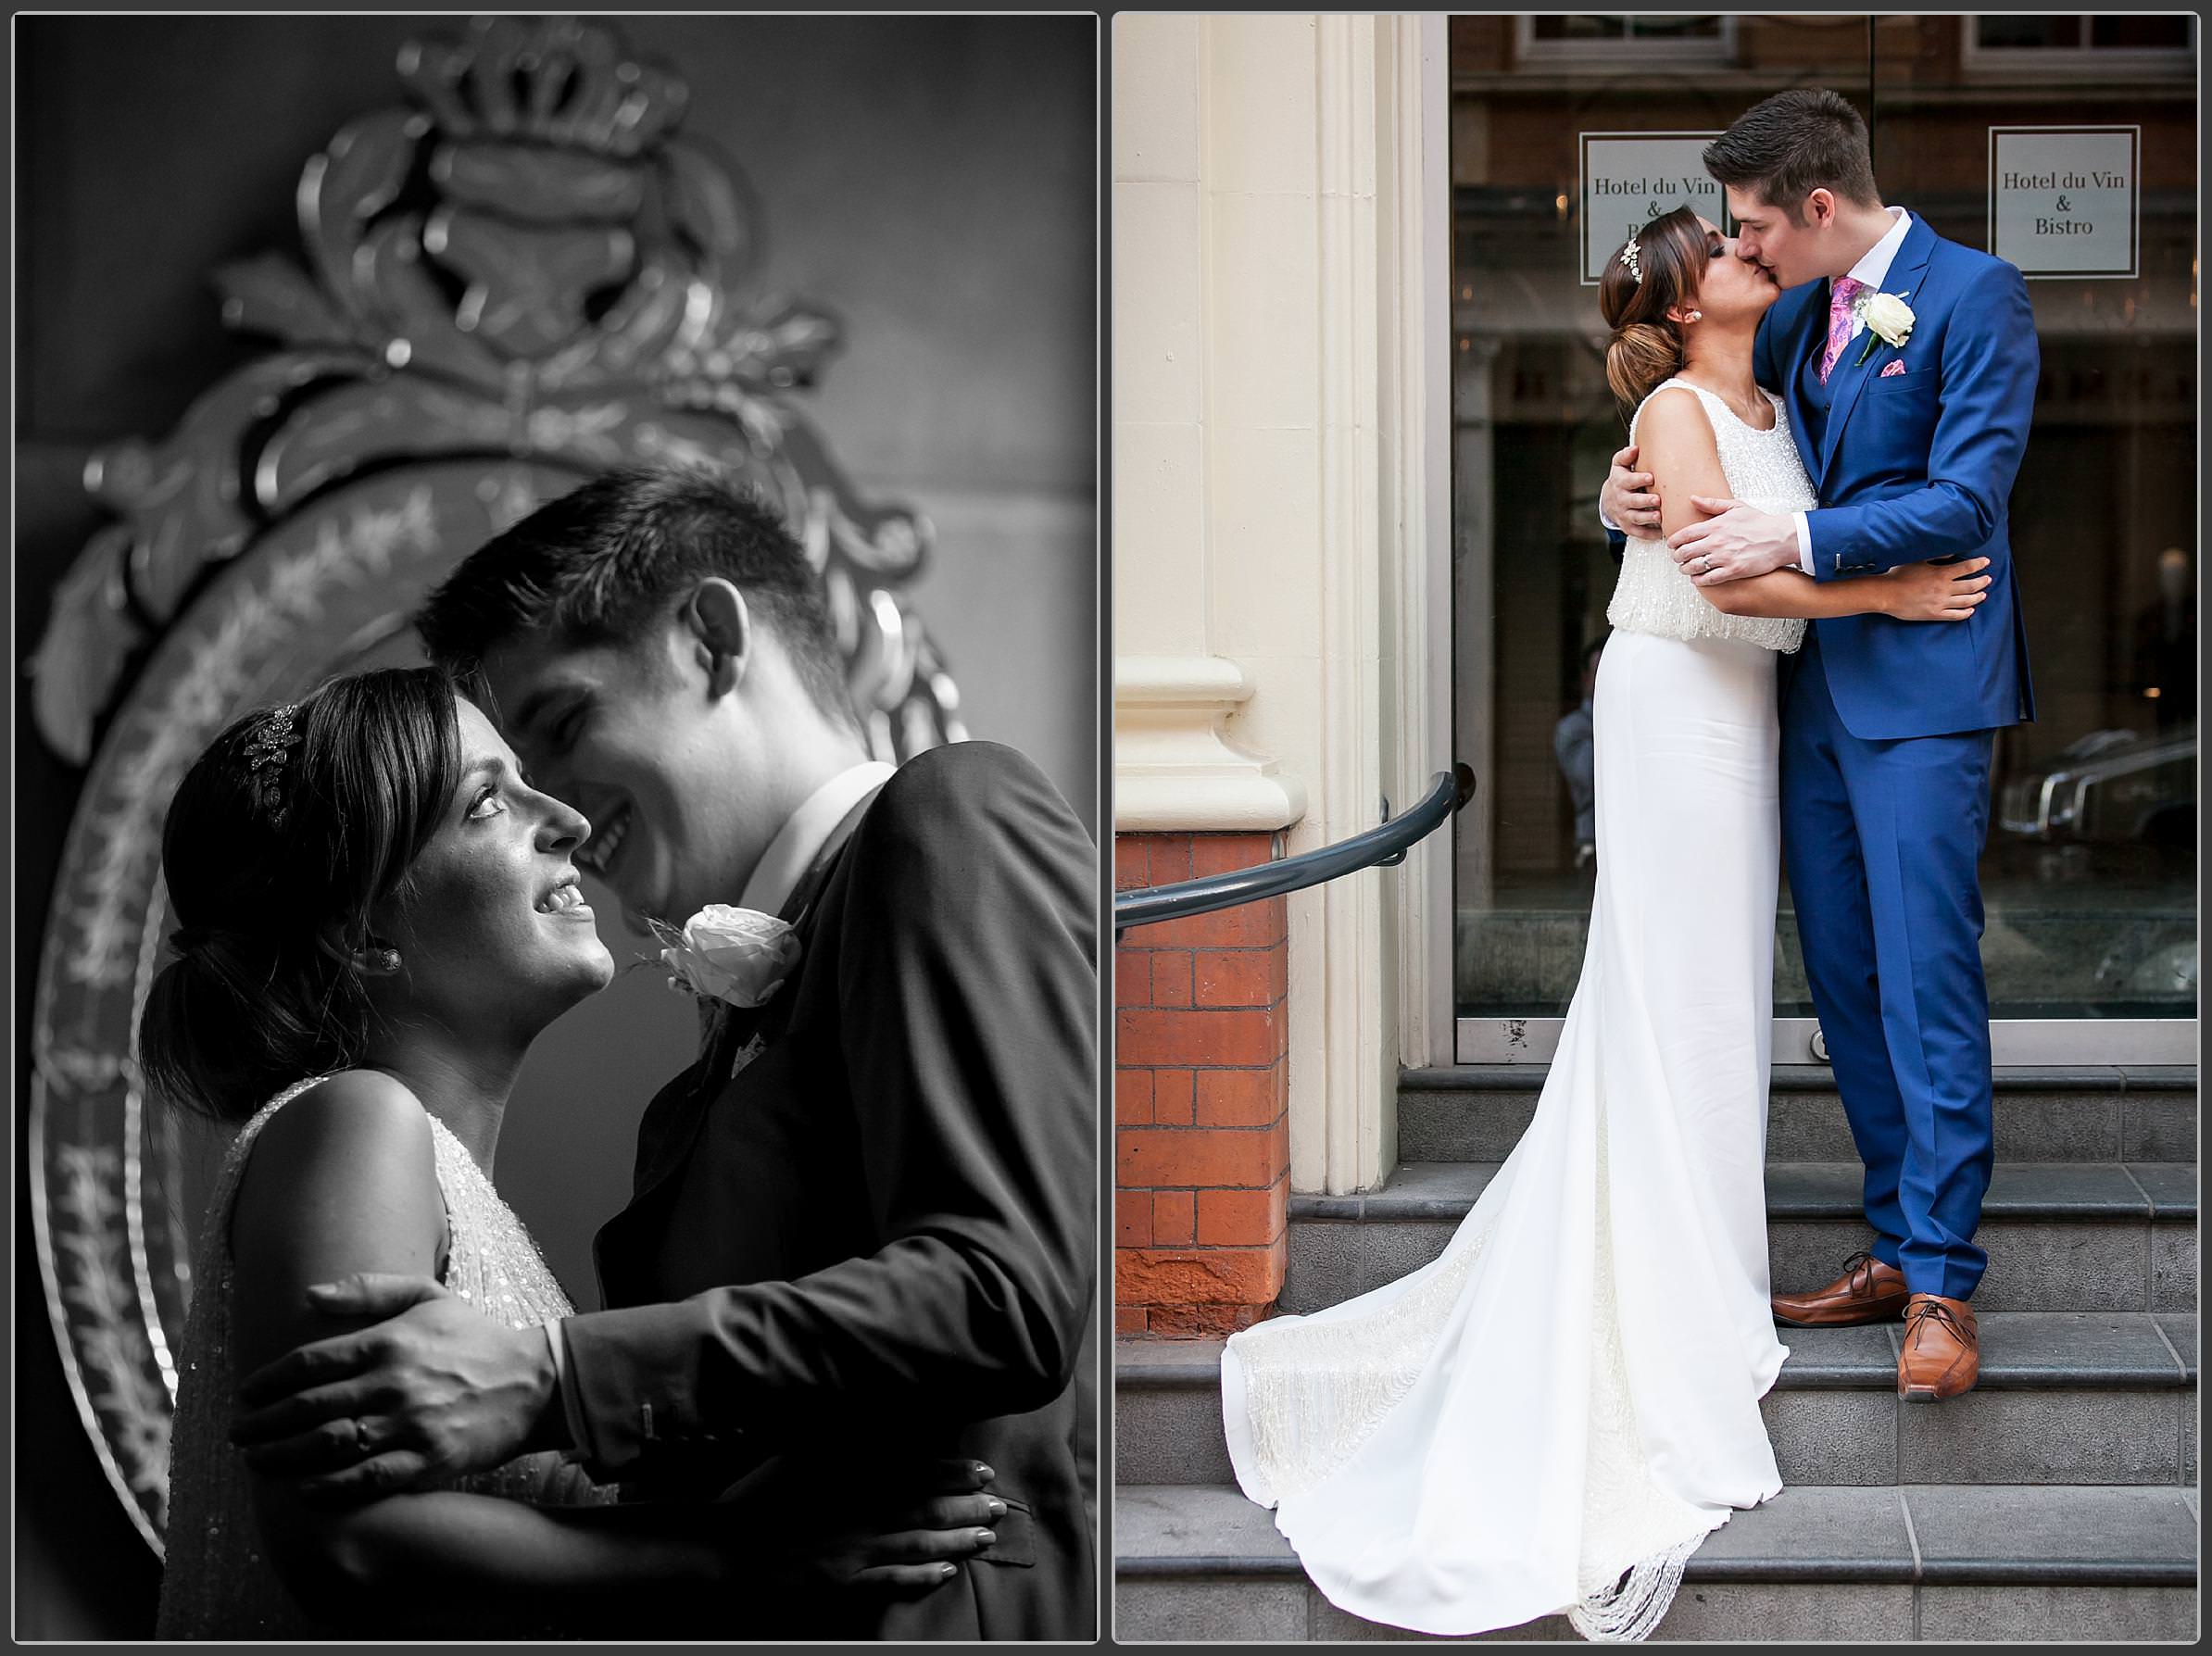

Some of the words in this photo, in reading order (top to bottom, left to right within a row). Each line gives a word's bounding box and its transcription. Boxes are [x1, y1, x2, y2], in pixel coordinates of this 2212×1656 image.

[1594, 178, 1646, 194] Hotel
[1653, 178, 1676, 194] du
[1682, 177, 1716, 194] Vin
[2004, 172, 2055, 189] Hotel
[2062, 172, 2086, 188] du
[2092, 171, 2125, 188] Vin
[1647, 200, 1662, 217] &
[2055, 194, 2071, 211] &
[2035, 218, 2093, 235] Bistro
